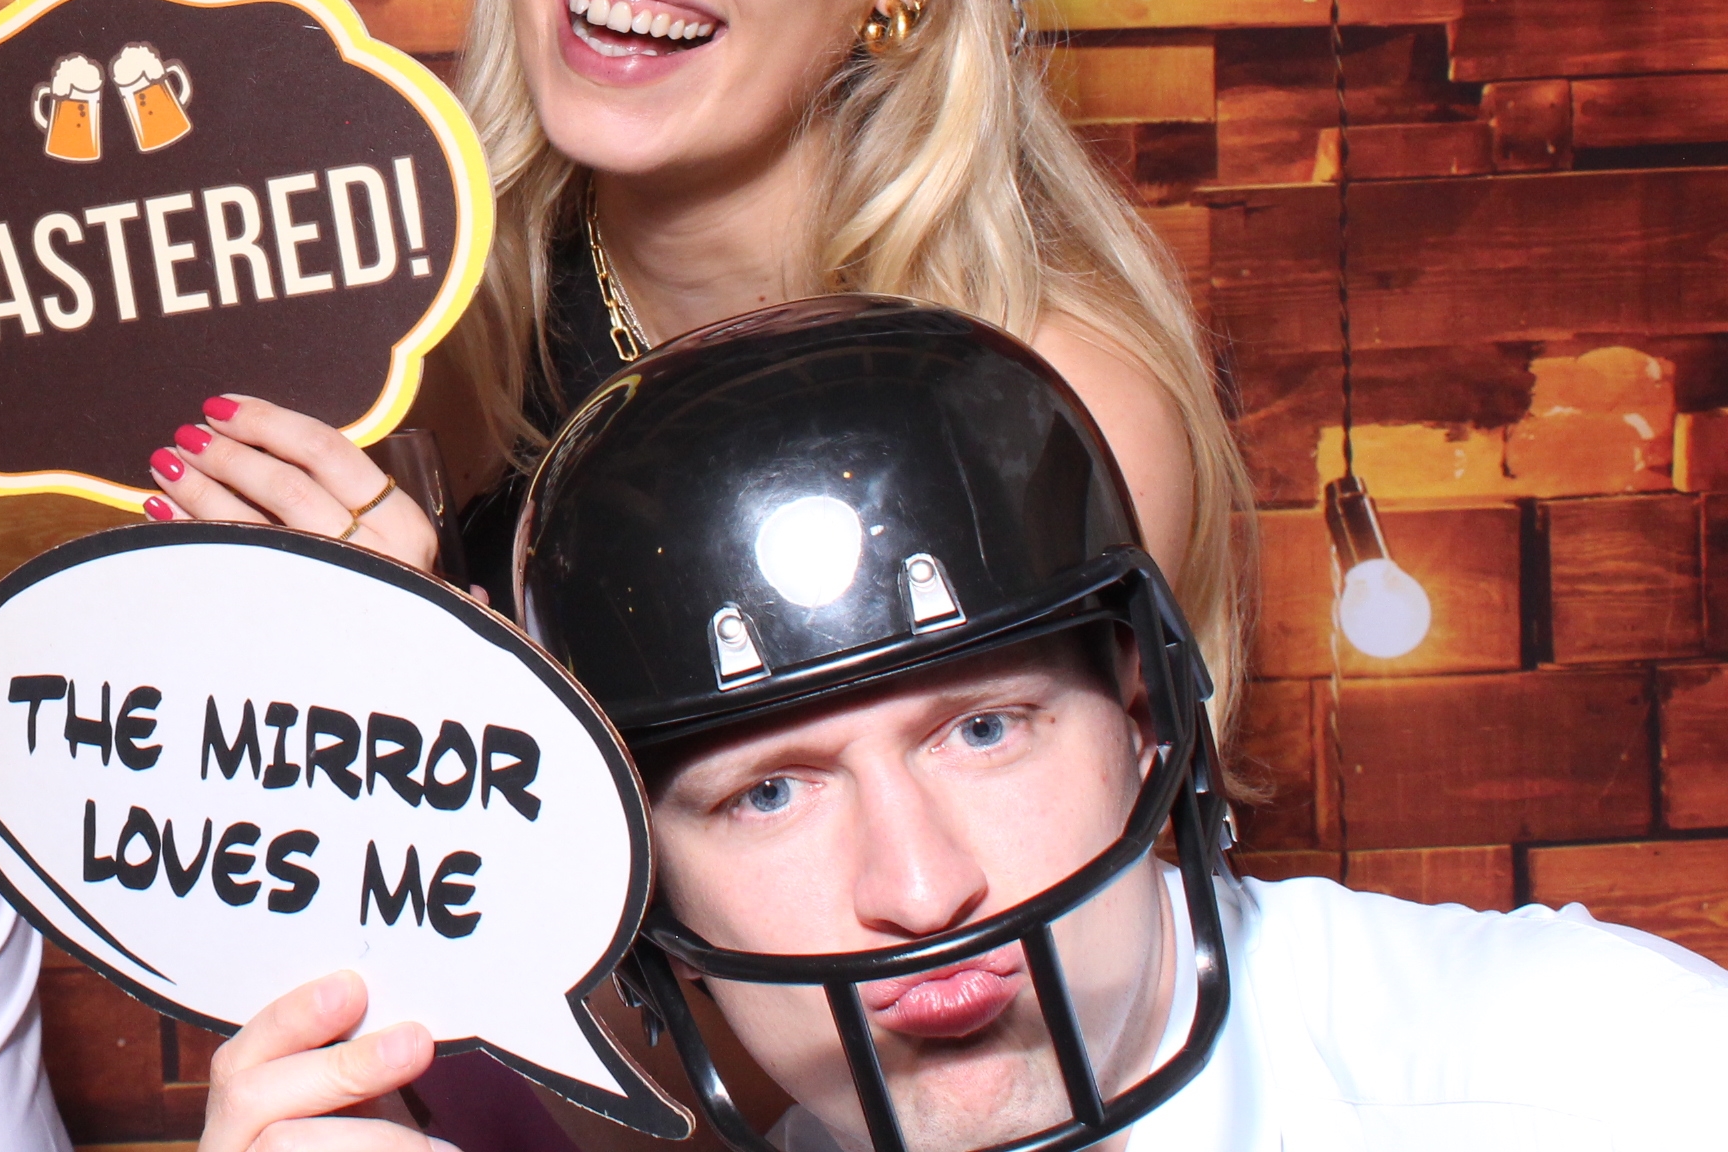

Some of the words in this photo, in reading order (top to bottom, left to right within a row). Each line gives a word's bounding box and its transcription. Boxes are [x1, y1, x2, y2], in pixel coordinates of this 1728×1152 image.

[8, 674, 163, 771] THE
[201, 695, 541, 821] MIRROR
[83, 799, 320, 913] LOVES
[360, 840, 482, 938] ME
